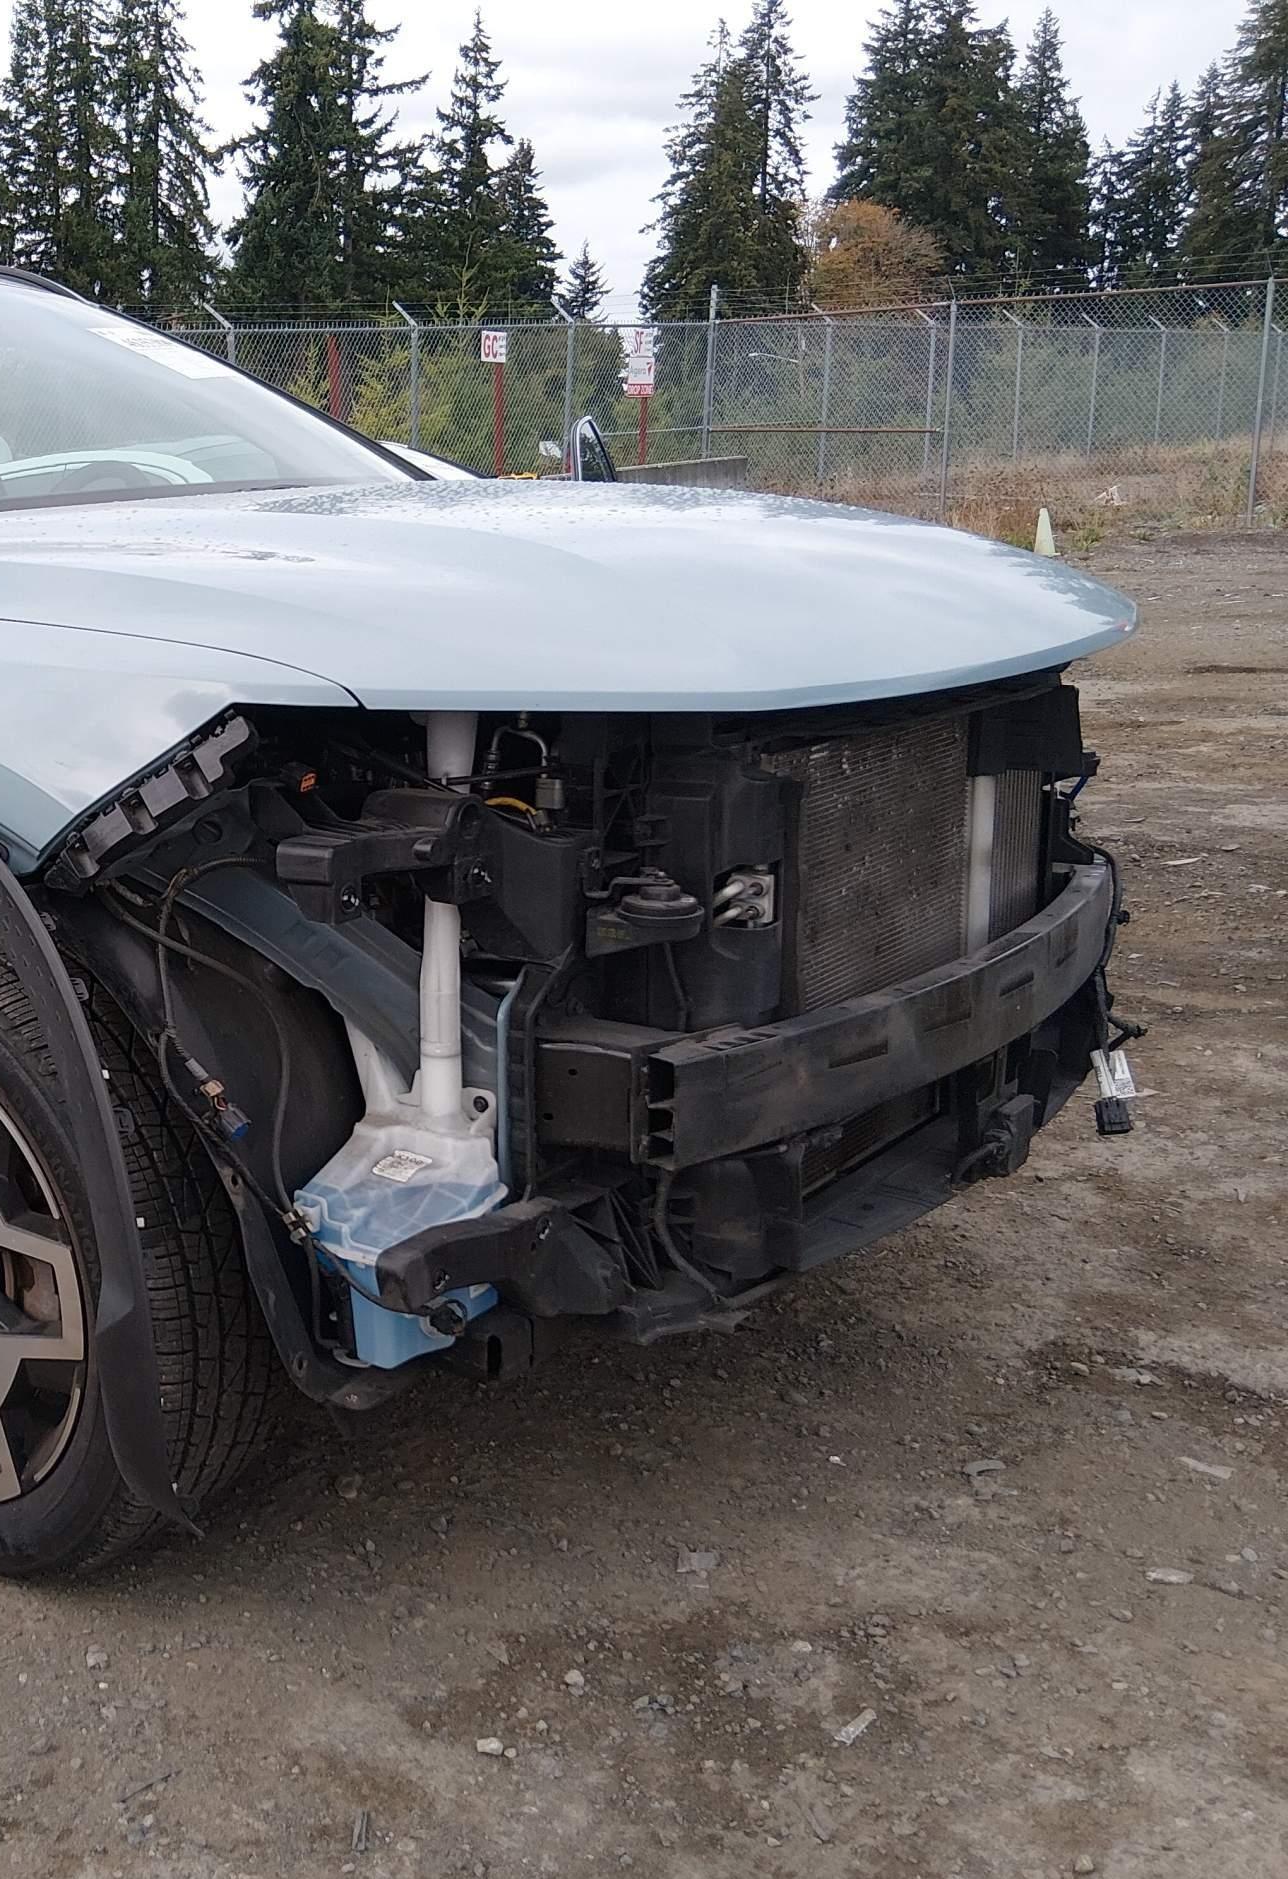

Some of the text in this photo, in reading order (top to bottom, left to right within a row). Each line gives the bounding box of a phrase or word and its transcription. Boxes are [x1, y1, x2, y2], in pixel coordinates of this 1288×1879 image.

[483, 334, 498, 359] GC
[633, 330, 645, 354] SF
[628, 384, 654, 395] DROP ZONE
